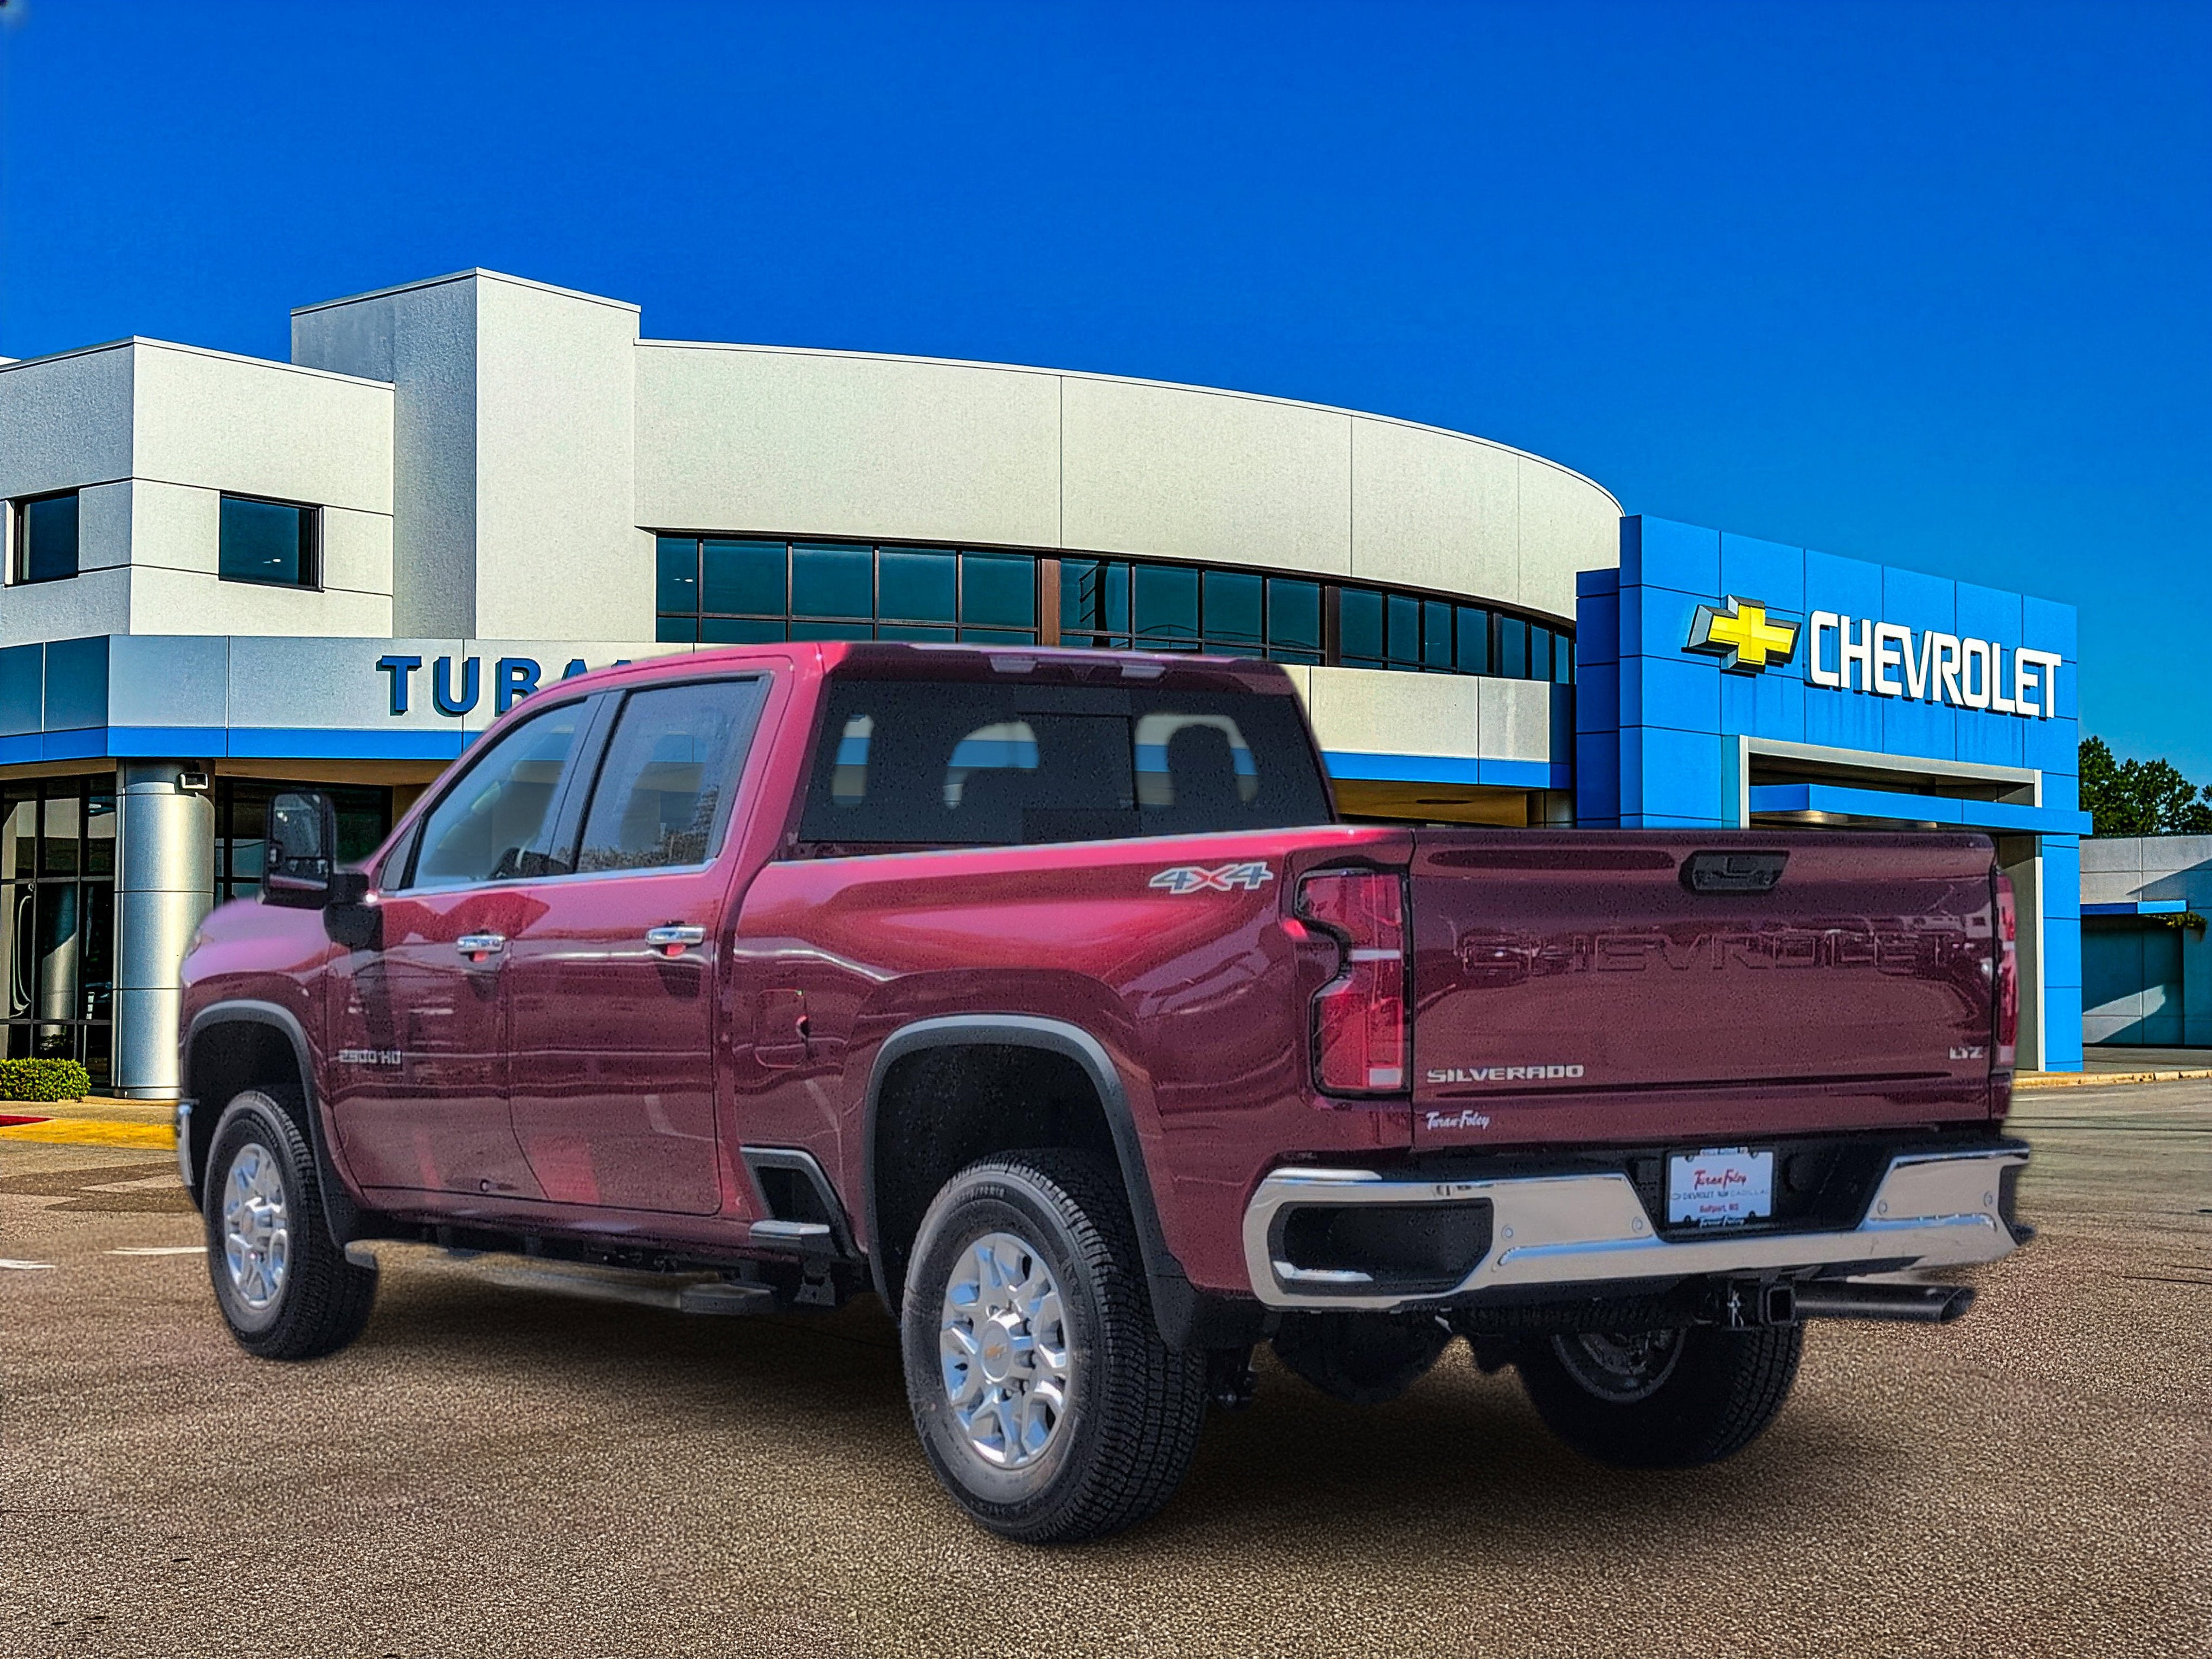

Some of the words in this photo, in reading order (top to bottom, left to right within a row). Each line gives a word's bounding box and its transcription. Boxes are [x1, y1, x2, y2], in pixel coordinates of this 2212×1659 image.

[1809, 610, 2062, 719] CHEVROLET
[376, 655, 632, 717] TUR
[338, 1049, 377, 1064] 2500
[1426, 1064, 1584, 1083] SILVERADO
